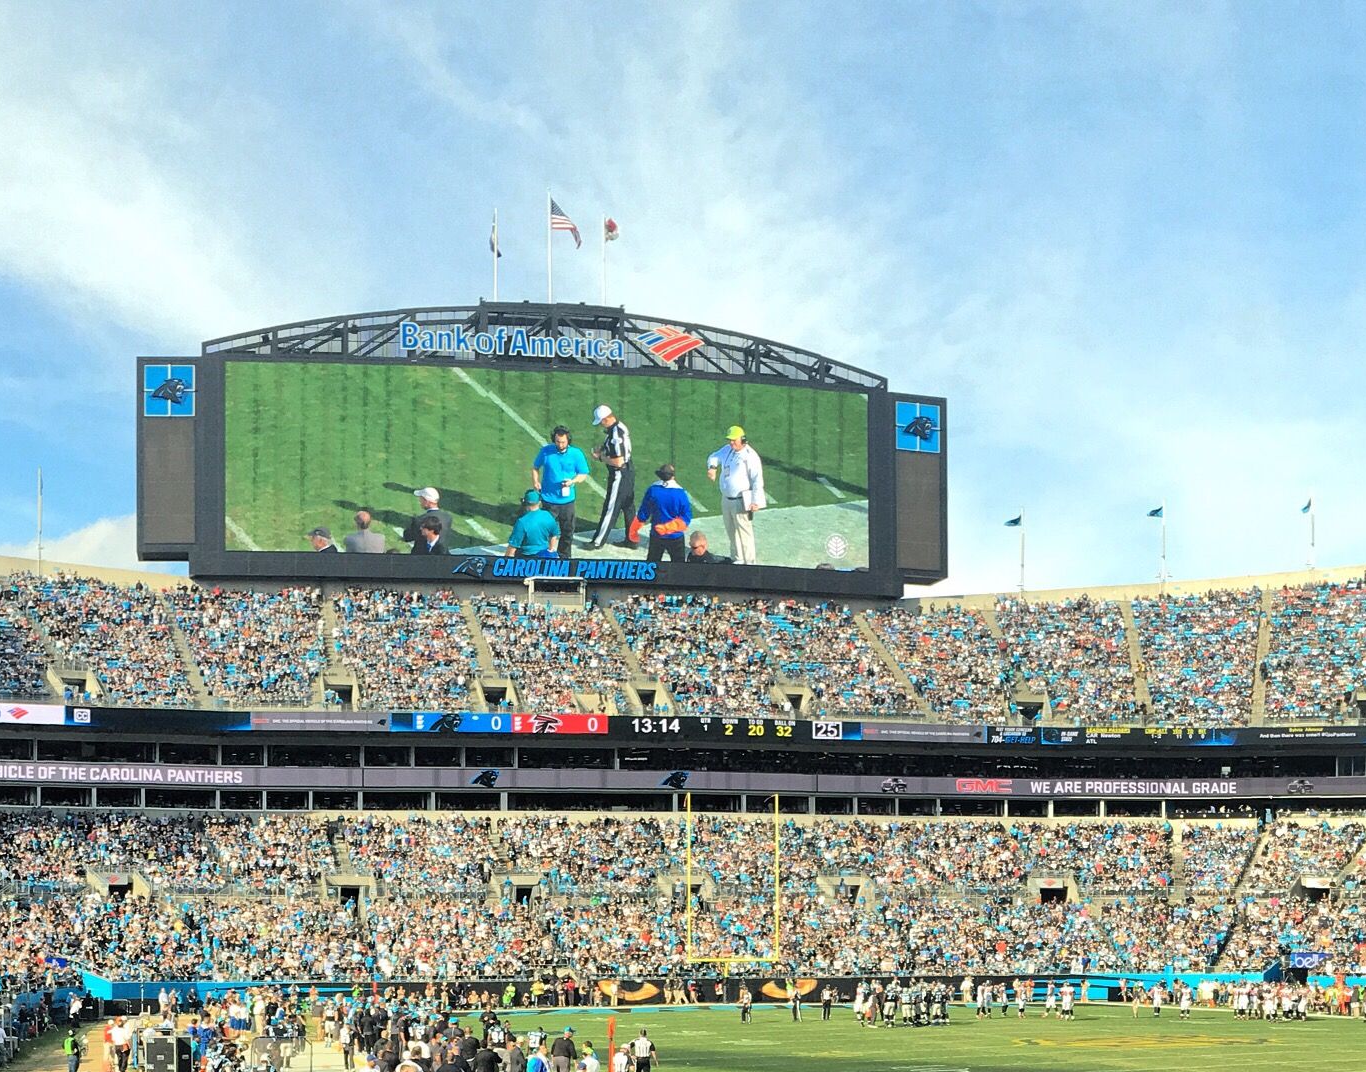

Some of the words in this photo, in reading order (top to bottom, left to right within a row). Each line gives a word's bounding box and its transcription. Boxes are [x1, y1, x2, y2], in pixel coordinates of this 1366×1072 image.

[399, 321, 472, 351] Bank
[473, 327, 508, 355] of
[510, 329, 625, 360] America
[492, 558, 570, 578] CAROLINA
[575, 559, 657, 580] PANTHERS
[491, 716, 502, 730] 0
[587, 717, 598, 731] 0
[631, 718, 680, 733] 13:14
[816, 723, 838, 737] 25
[724, 724, 733, 736] 2
[748, 724, 765, 736] 20
[776, 726, 793, 737] 32
[38, 766, 56, 780] OF
[59, 767, 86, 781] THE
[89, 768, 163, 782] CAROLINA
[168, 769, 243, 784] PANTHERS
[955, 778, 1012, 793] GMC
[1030, 781, 1050, 794] WE
[1053, 781, 1082, 794] ARE
[1085, 781, 1188, 795] PROFESSIONAL
[1192, 781, 1237, 795] GRADE
